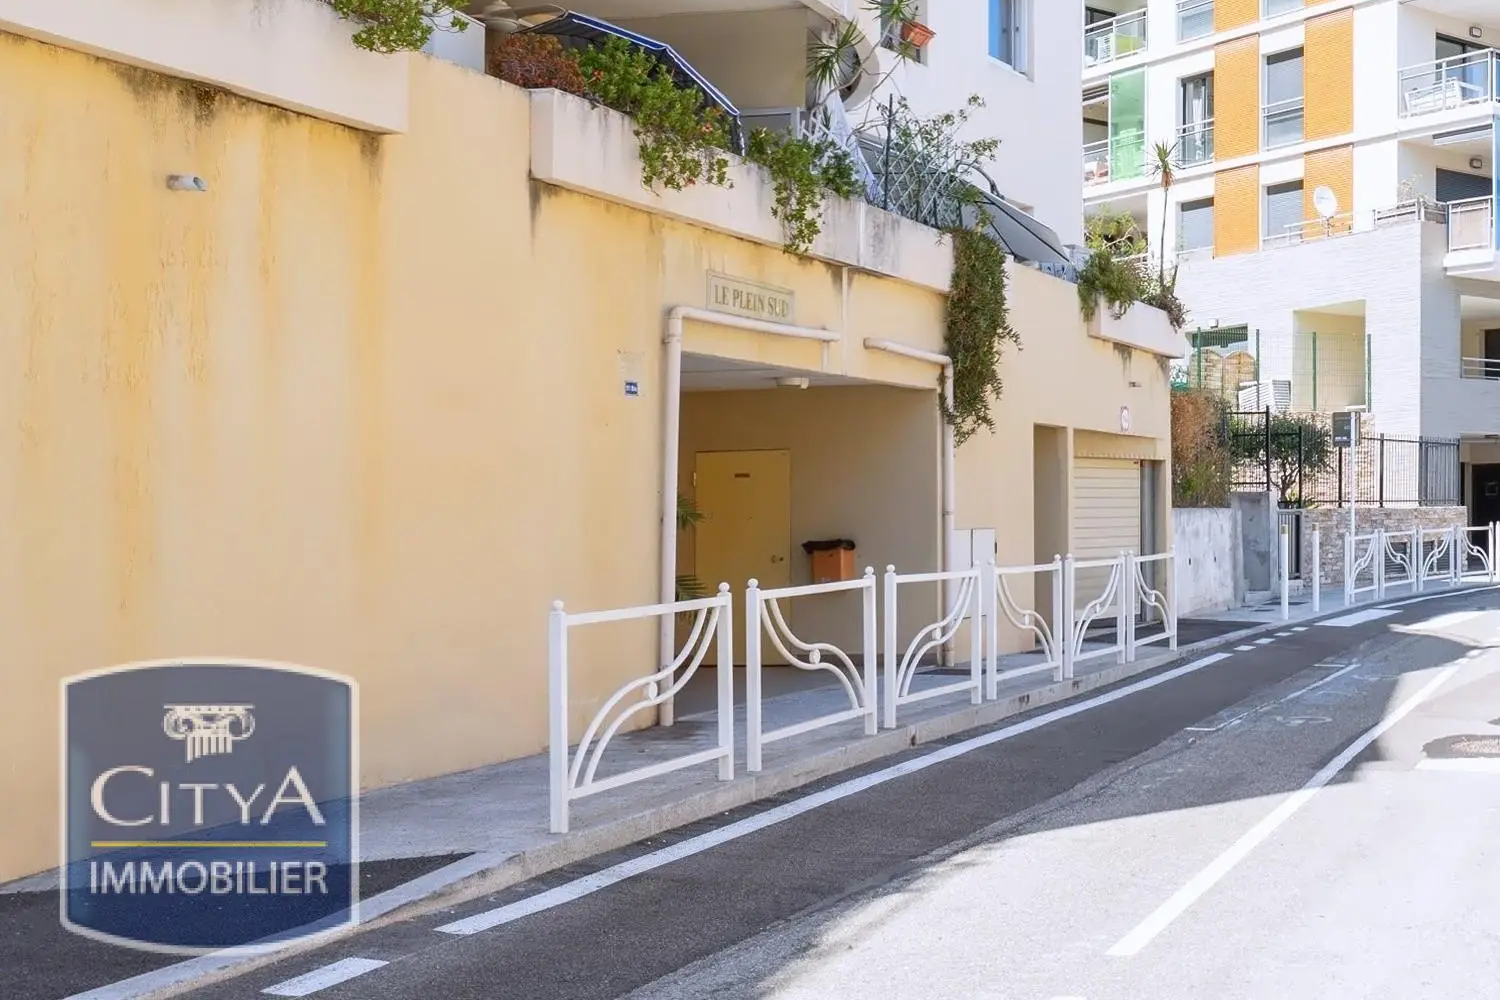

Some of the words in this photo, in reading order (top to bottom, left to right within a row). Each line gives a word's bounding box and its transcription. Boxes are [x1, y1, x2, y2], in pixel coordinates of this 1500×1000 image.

[713, 284, 729, 306] LE
[732, 288, 765, 313] PLEIN
[767, 295, 789, 318] SUD
